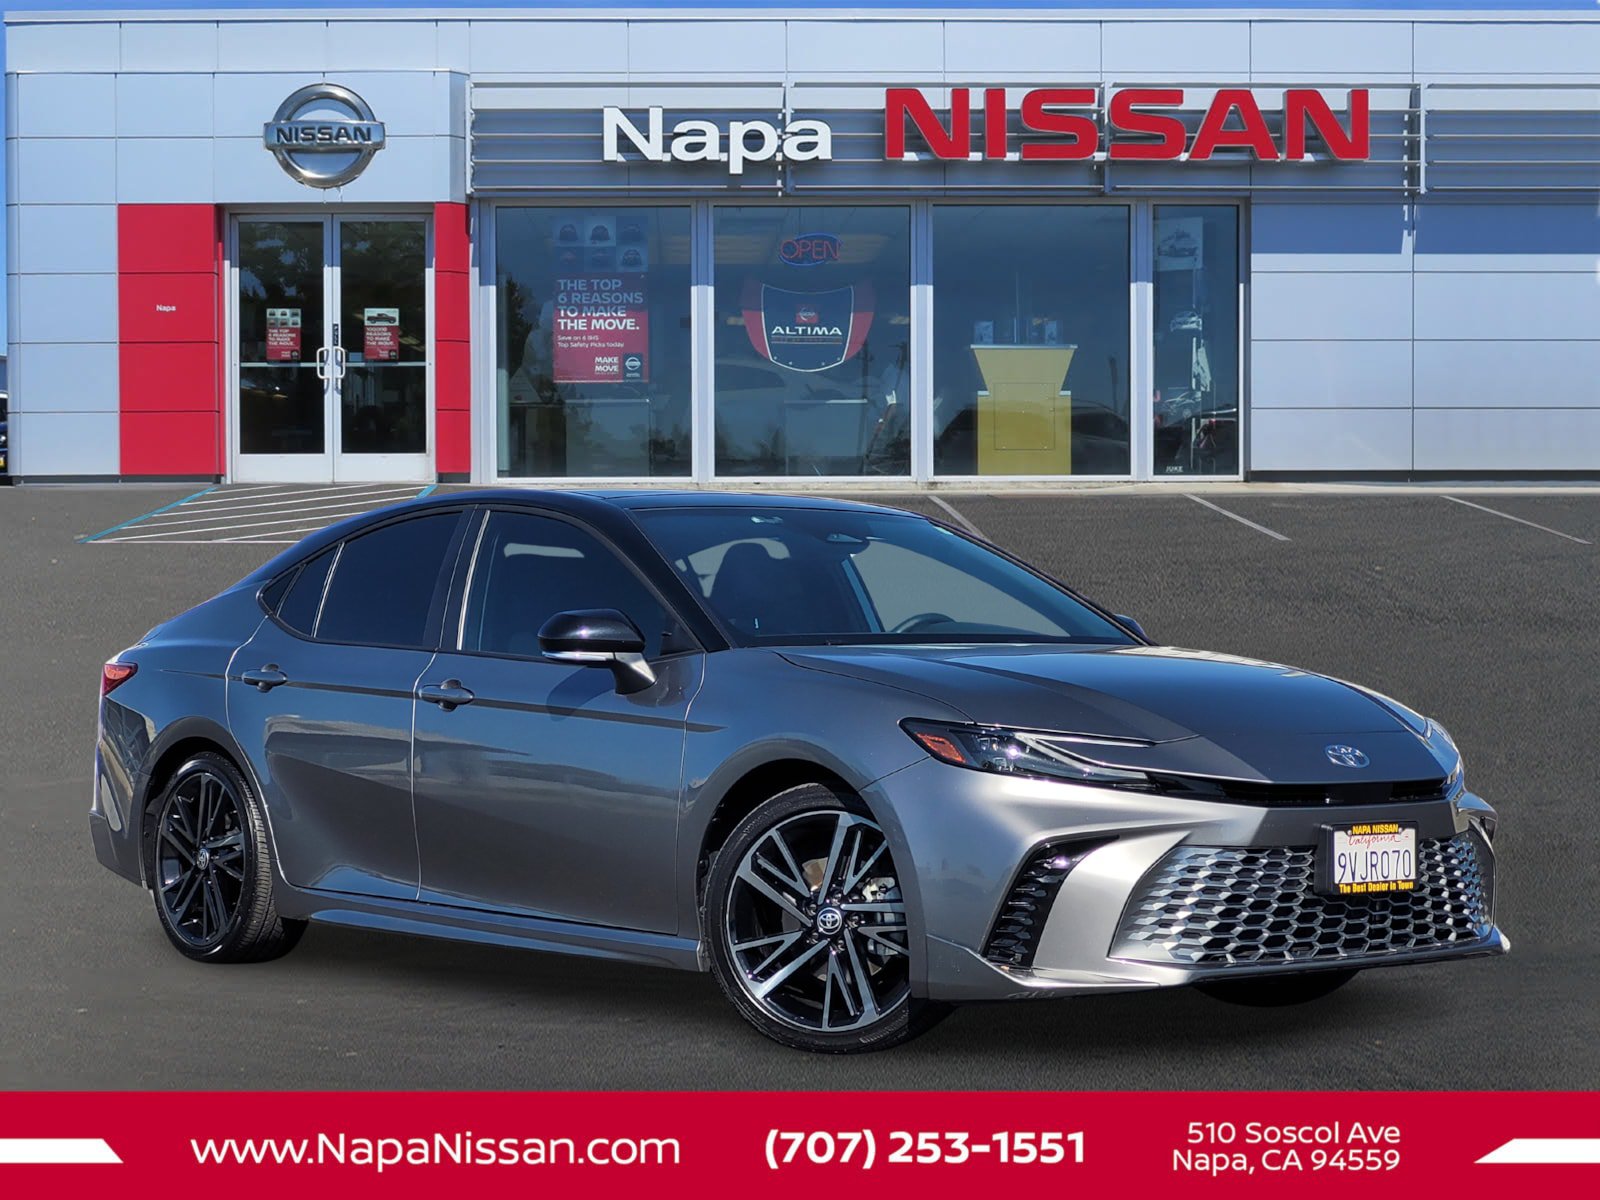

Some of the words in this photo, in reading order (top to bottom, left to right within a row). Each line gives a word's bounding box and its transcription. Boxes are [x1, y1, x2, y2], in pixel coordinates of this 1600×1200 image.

[276, 126, 372, 142] NISSAN
[603, 106, 833, 175] Napa
[885, 87, 1370, 162] NISSAN
[780, 239, 842, 261] OPEN
[557, 279, 588, 291] THE
[591, 279, 622, 291] TOP
[558, 292, 568, 304] 6
[571, 292, 644, 304] REASONS
[156, 304, 177, 313] Napa
[557, 305, 579, 318] TO
[582, 305, 627, 317] MAKE
[557, 318, 588, 331] THE
[591, 318, 640, 331] MOVE.
[771, 326, 843, 335] ALTIMA
[1352, 826, 1371, 835] NAPA
[1372, 824, 1399, 834] NISSAN
[1338, 849, 1412, 884] 9VJR070
[1339, 884, 1351, 894] The
[1352, 883, 1366, 893] Best
